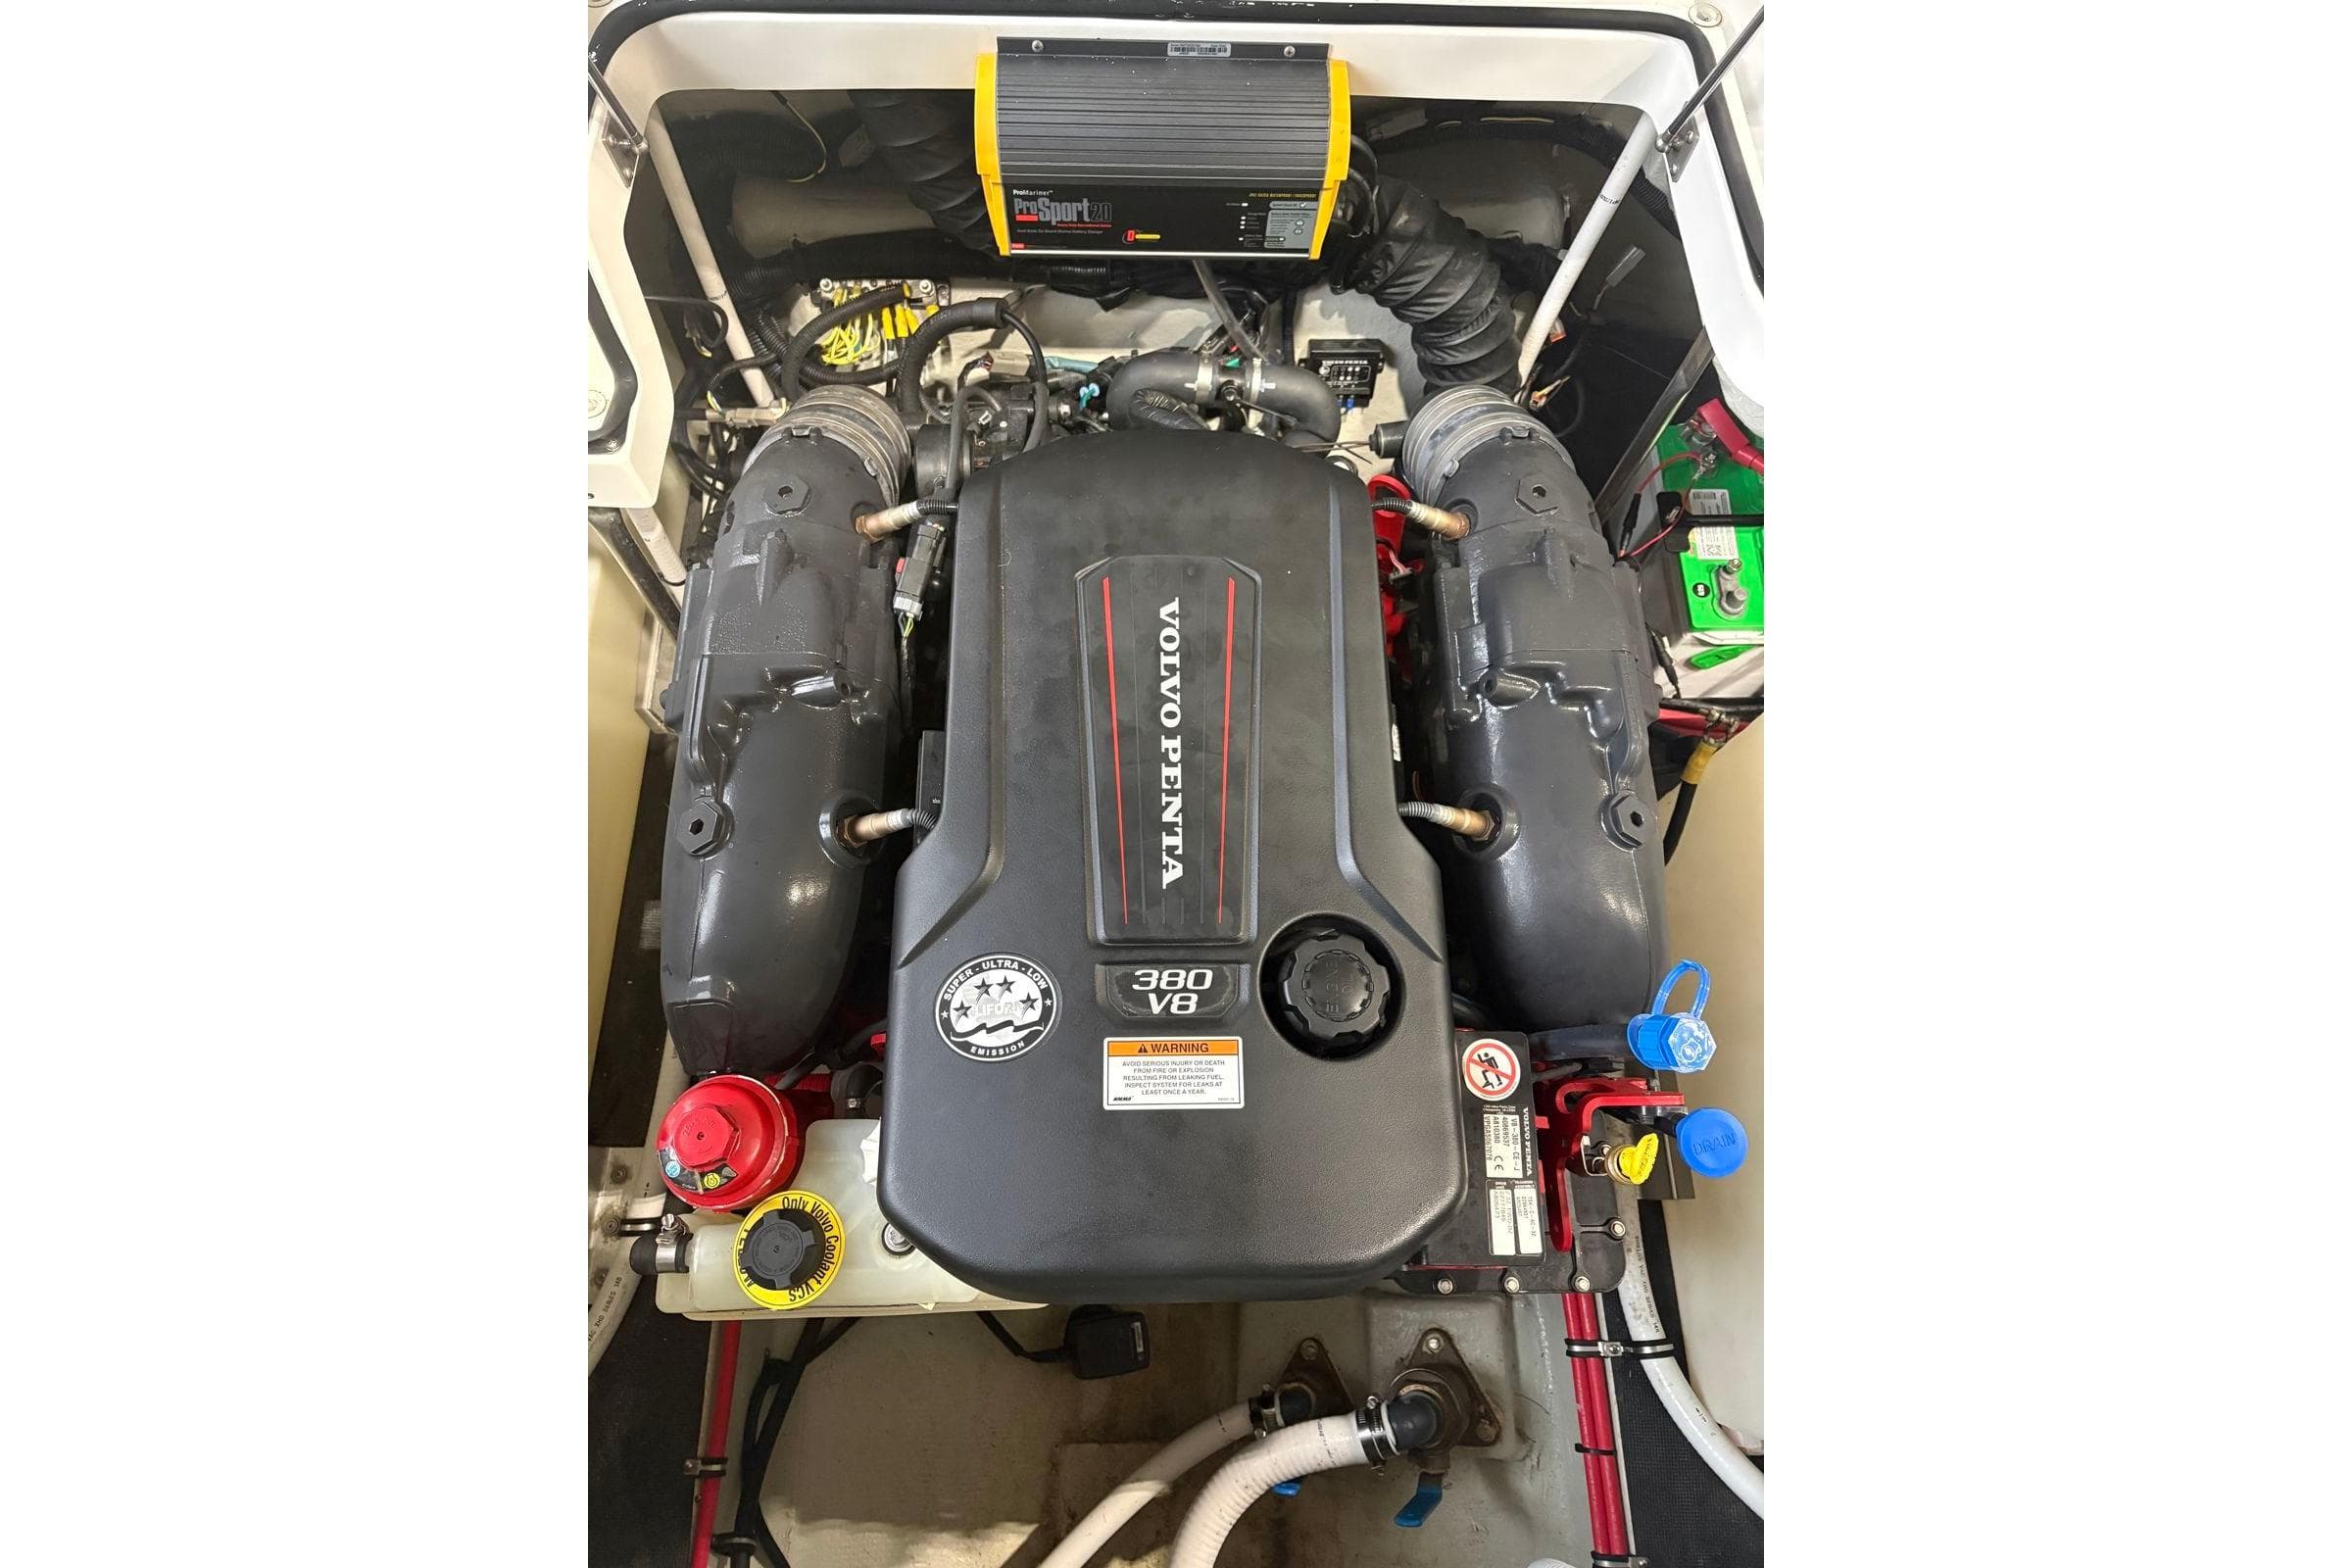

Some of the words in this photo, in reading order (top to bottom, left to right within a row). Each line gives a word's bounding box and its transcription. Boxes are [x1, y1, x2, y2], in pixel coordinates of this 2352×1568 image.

[1159, 597, 1182, 728] VOLVO
[1160, 735, 1184, 890] PENTA
[944, 968, 974, 1001] SUPER
[982, 959, 1019, 970] ULTRA
[1026, 967, 1049, 990] LOW
[1132, 969, 1213, 991] 380
[1148, 993, 1199, 1015] V8
[970, 1040, 1025, 1056] EMISSION
[1151, 1043, 1209, 1054] WARNING
[1692, 1132, 1737, 1155] DRAIN
[782, 1196, 808, 1211] Only
[810, 1200, 834, 1233] Volvo
[815, 1235, 839, 1286] Coolant
[789, 1282, 815, 1302] VCS
